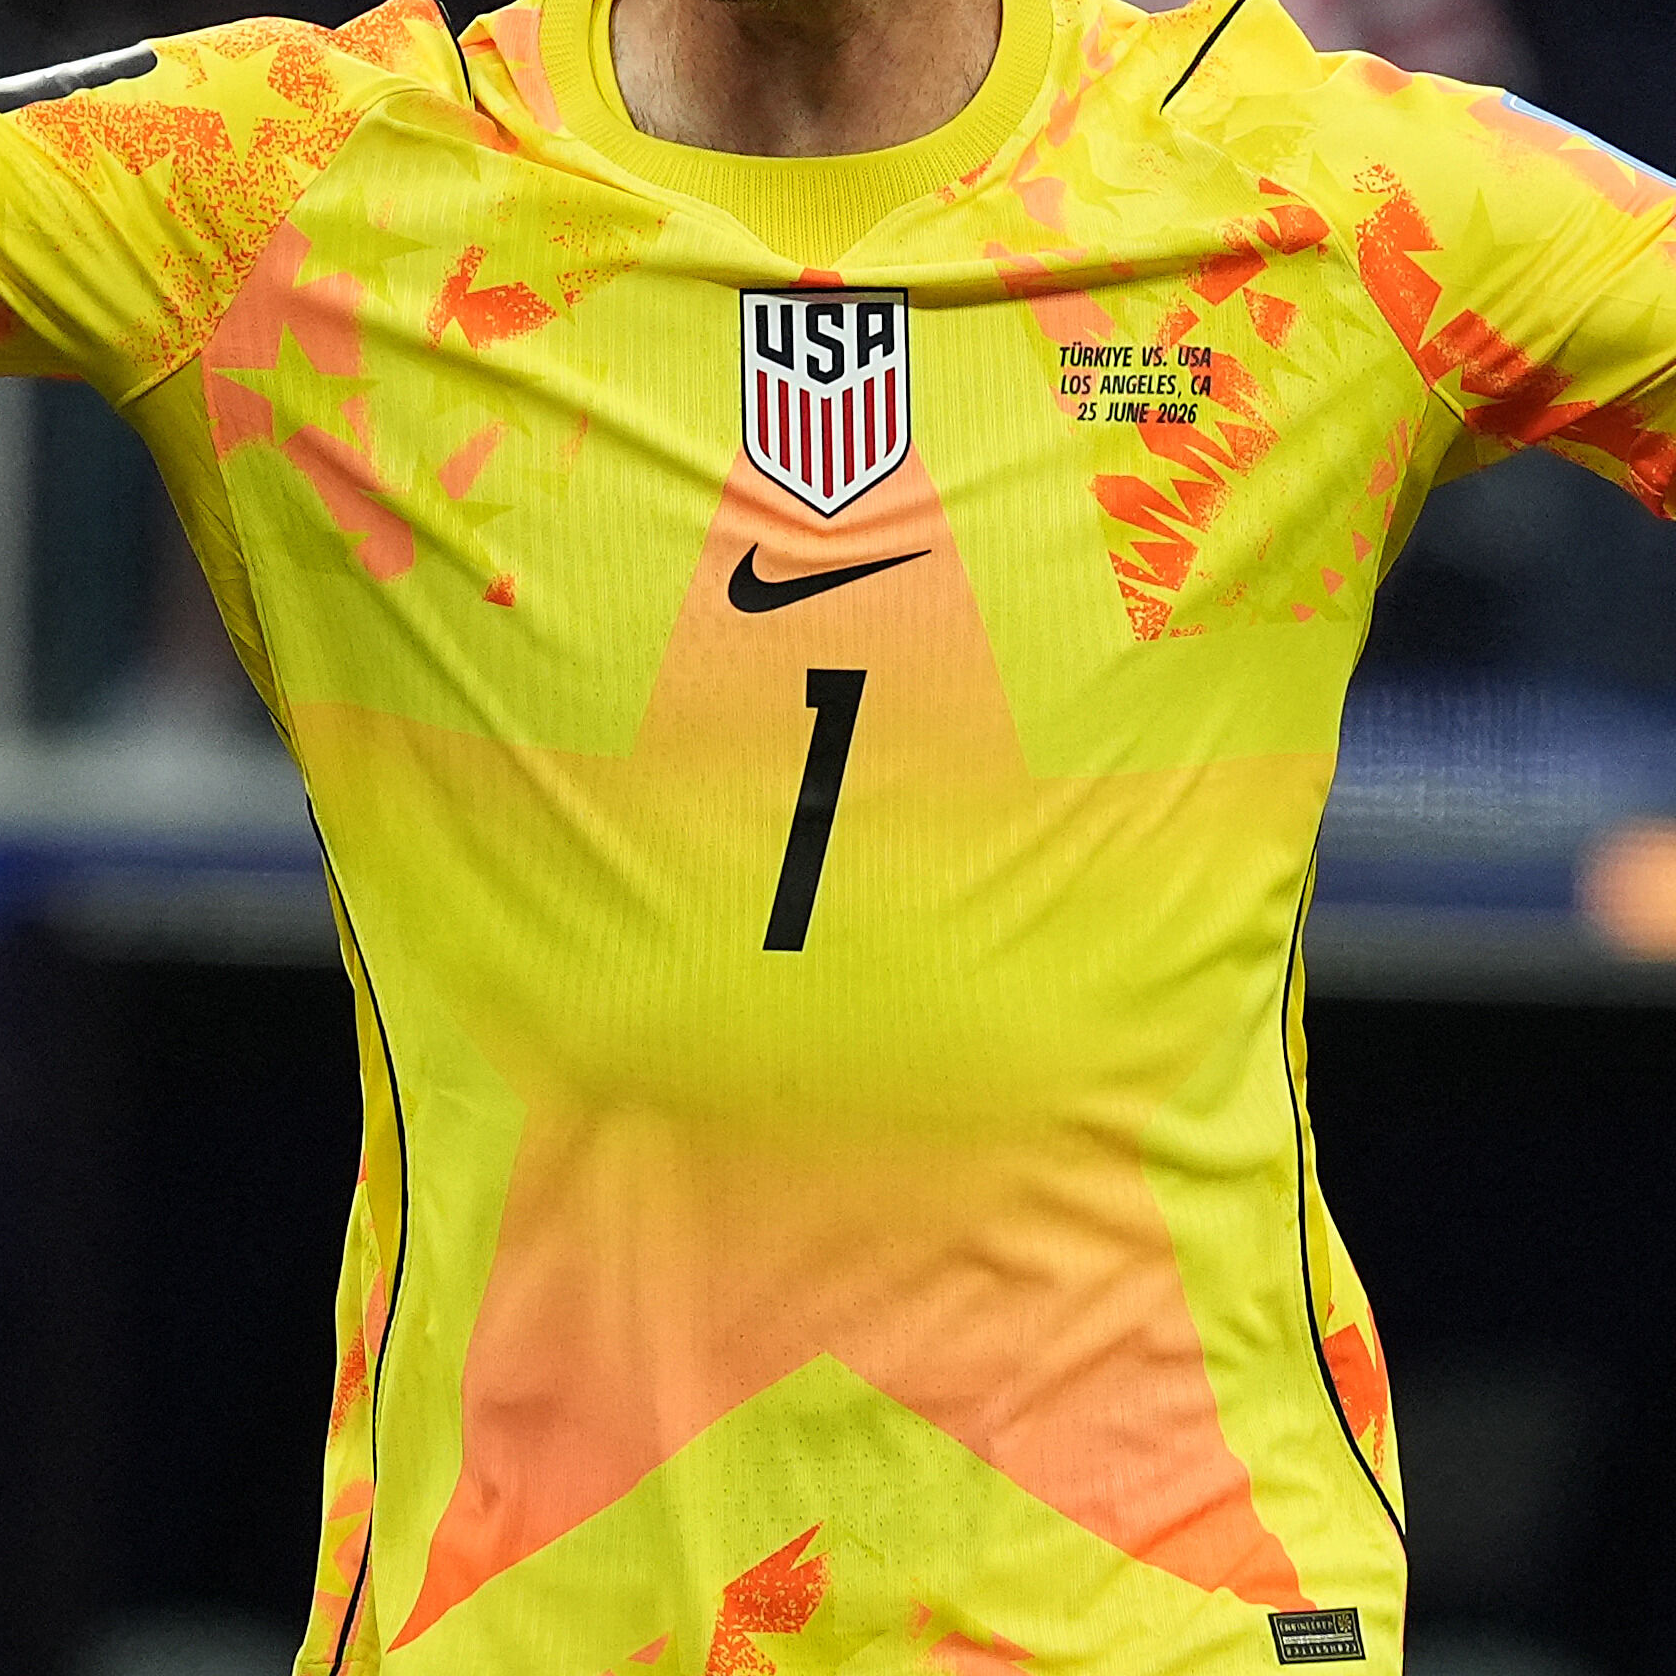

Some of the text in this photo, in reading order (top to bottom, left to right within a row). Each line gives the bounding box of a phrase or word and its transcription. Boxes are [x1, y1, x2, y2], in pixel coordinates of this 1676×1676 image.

[754, 301, 896, 385] USA
[1059, 341, 1212, 367] TÜRKIYE VS. USA
[1060, 375, 1212, 399] LOS ANGELES, CA
[1077, 402, 1199, 424] 25 JUNE 2026
[762, 668, 868, 952] 1
